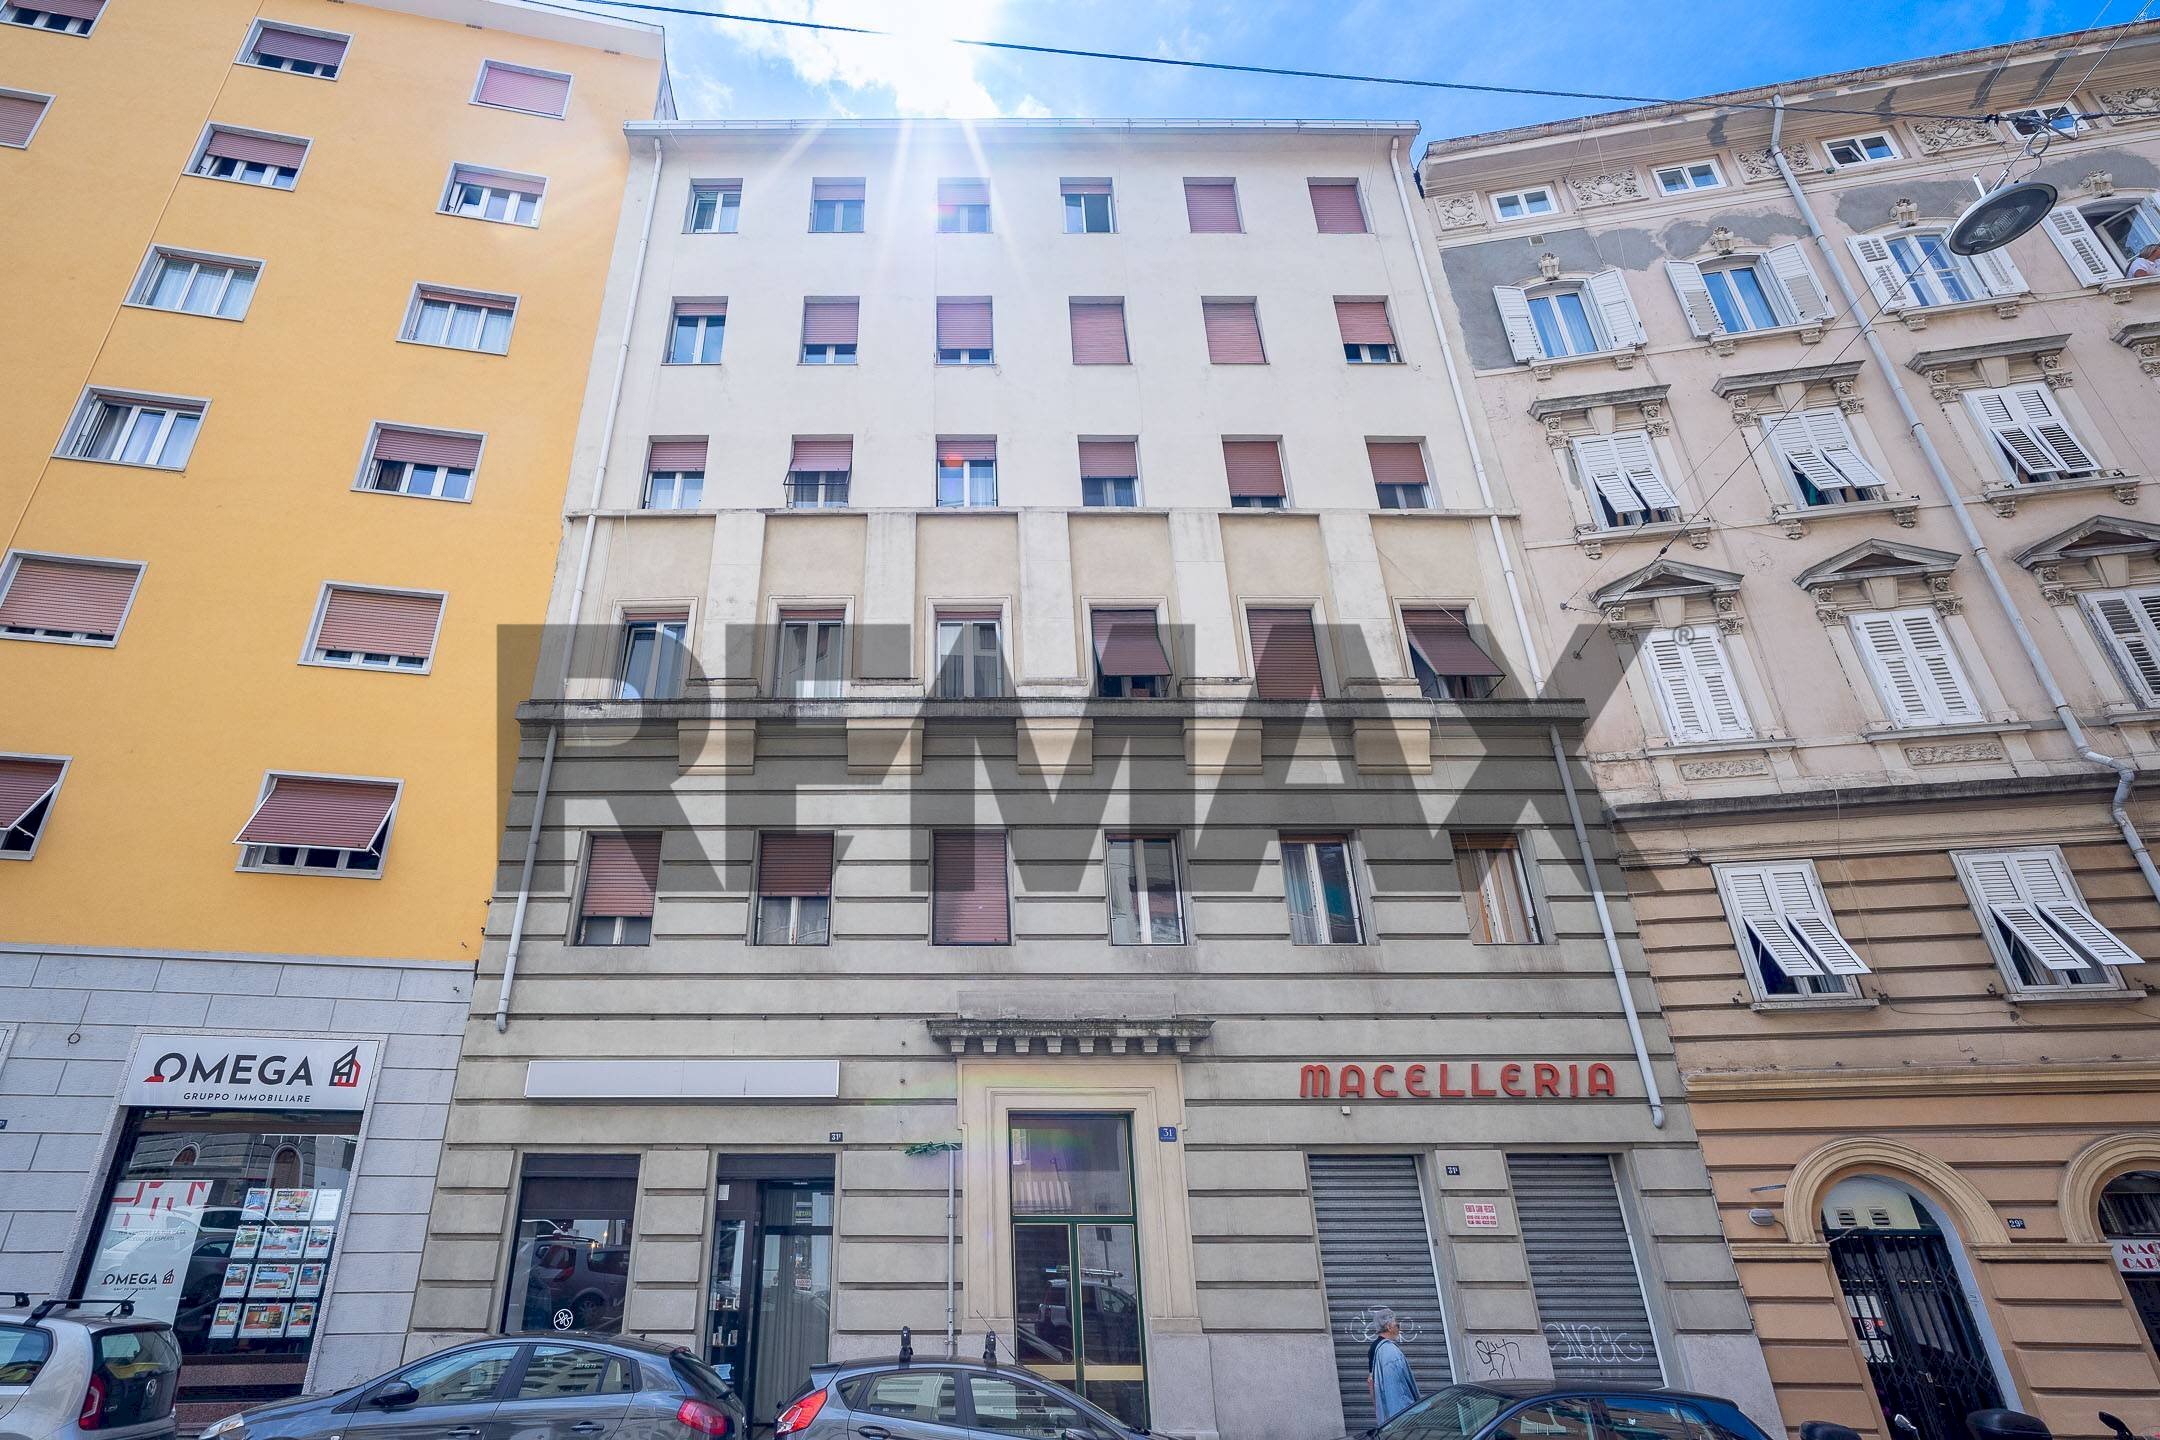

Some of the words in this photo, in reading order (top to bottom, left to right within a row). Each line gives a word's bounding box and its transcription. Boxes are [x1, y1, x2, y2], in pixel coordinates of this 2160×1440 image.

[143, 1052, 313, 1086] OMEGA
[1300, 1063, 1616, 1097] MACELLERIA
[183, 1092, 230, 1101] GRUPPO
[234, 1093, 311, 1103] IMMOBILIARE
[101, 1273, 157, 1285] OMEGA
